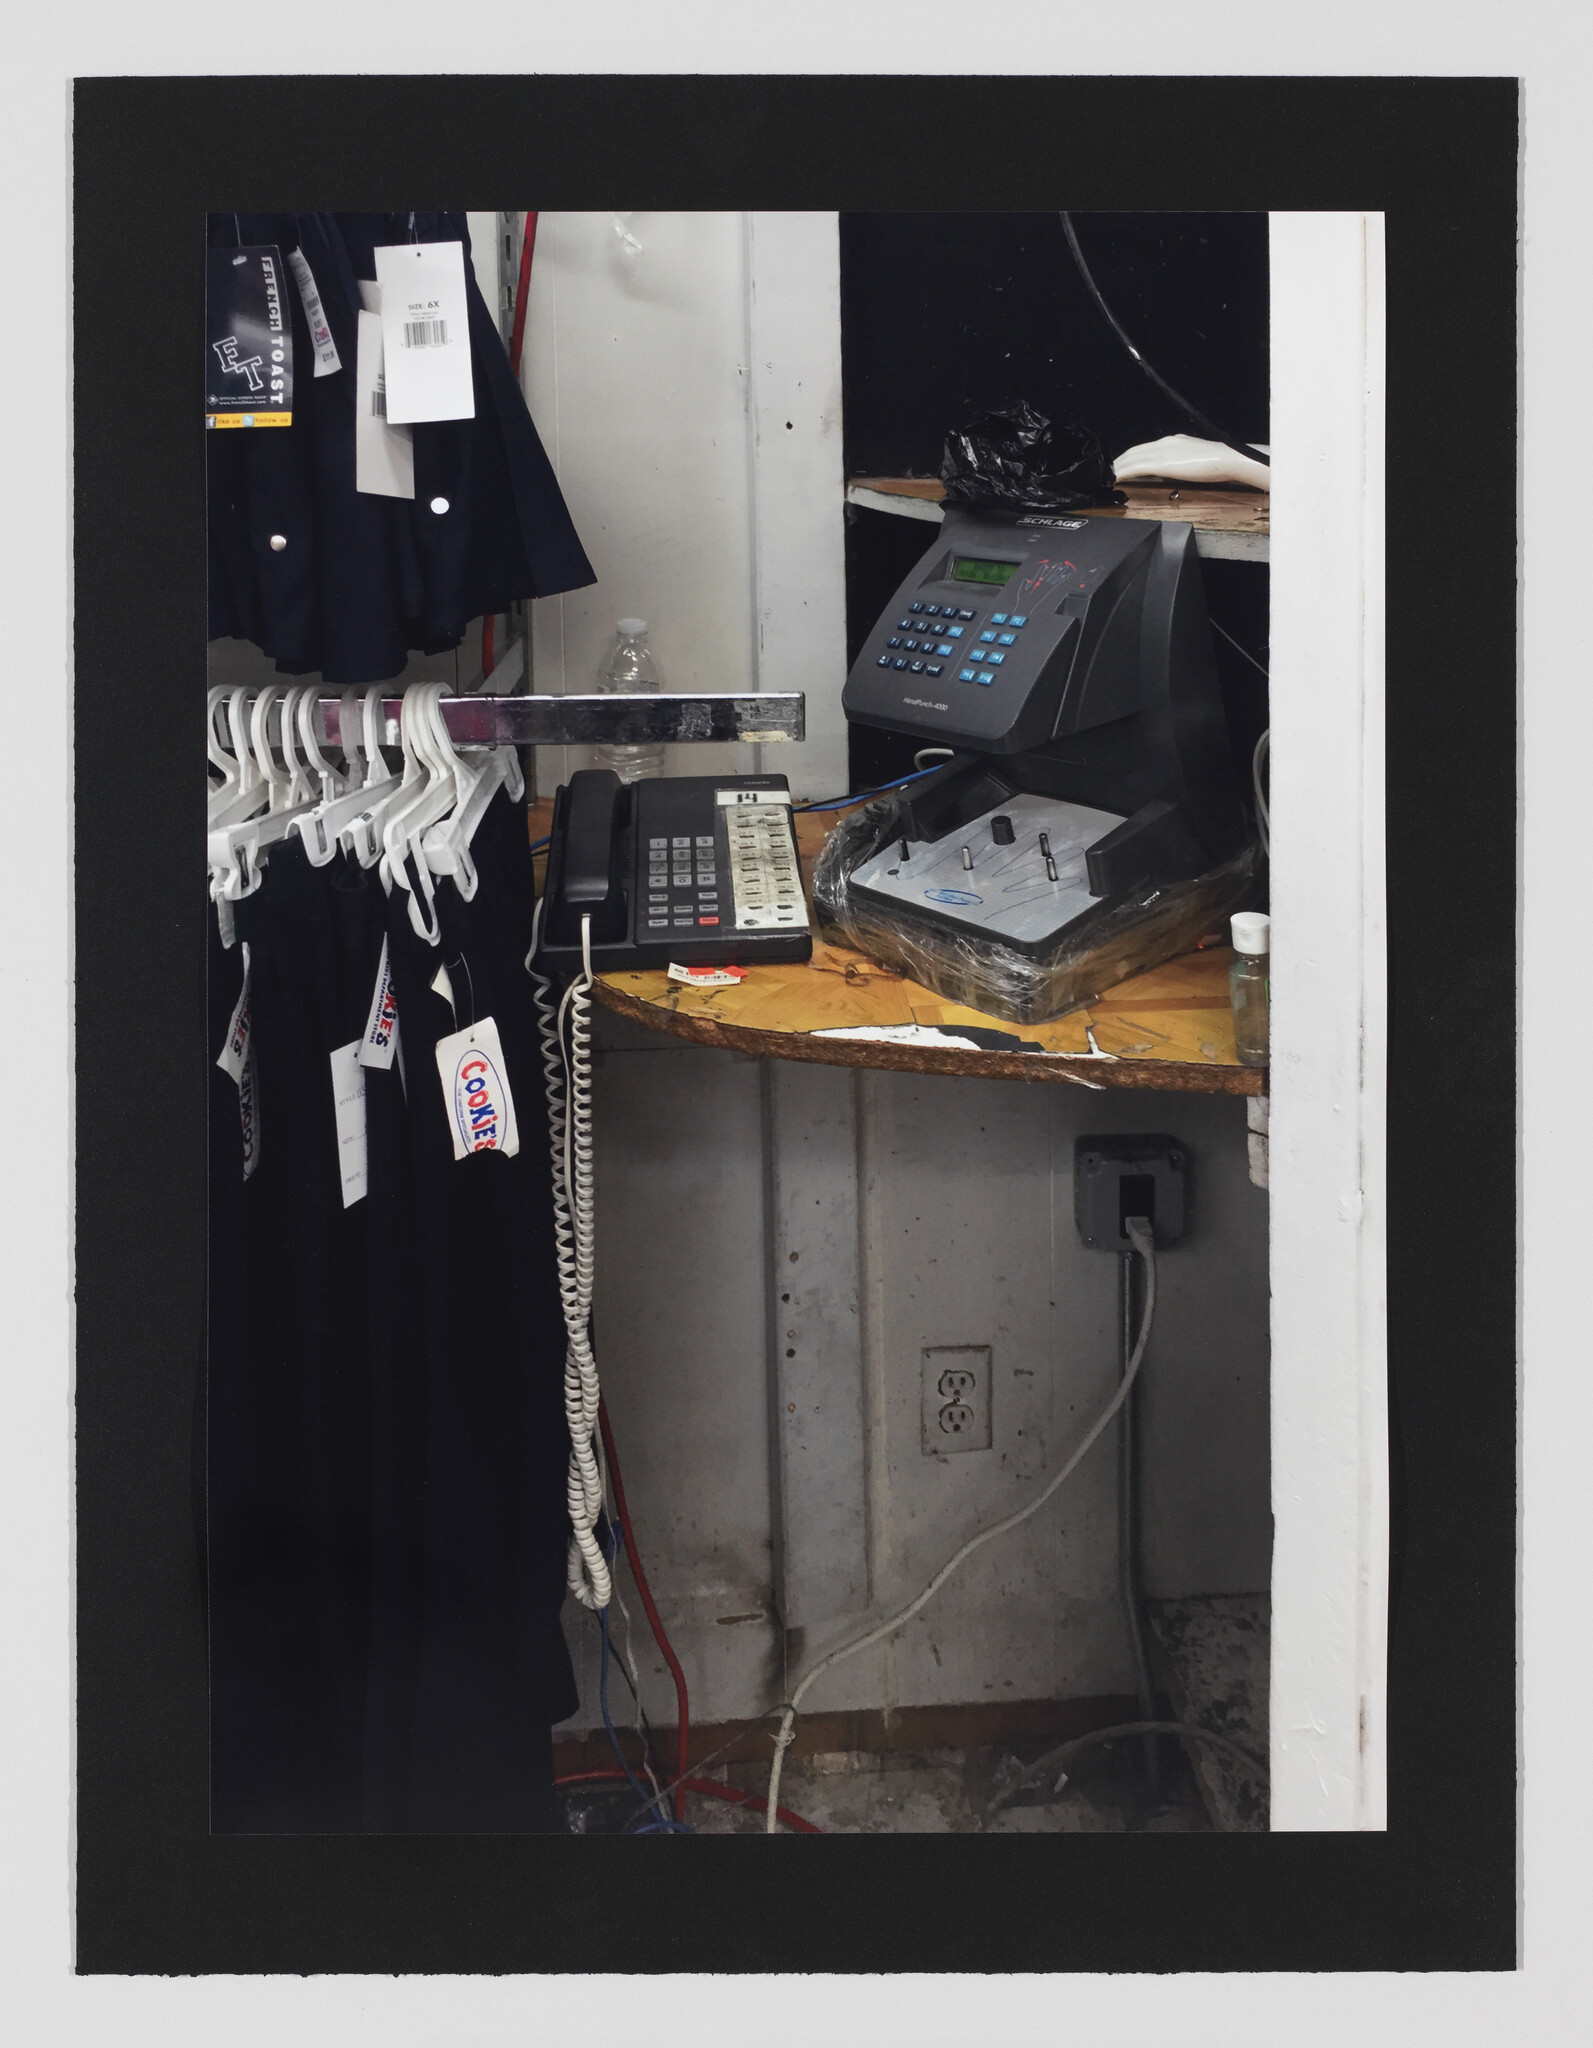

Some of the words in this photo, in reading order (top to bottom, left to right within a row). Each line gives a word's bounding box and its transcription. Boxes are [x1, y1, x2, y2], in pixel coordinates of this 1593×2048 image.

[261, 256, 283, 331] FRENCH
[427, 300, 440, 309] 6X
[270, 336, 285, 404] TOAST
[1018, 517, 1083, 528] SCHLAGE
[737, 793, 758, 803] 14
[375, 977, 388, 1022] DEPARTMENT
[368, 1023, 379, 1044] STORE
